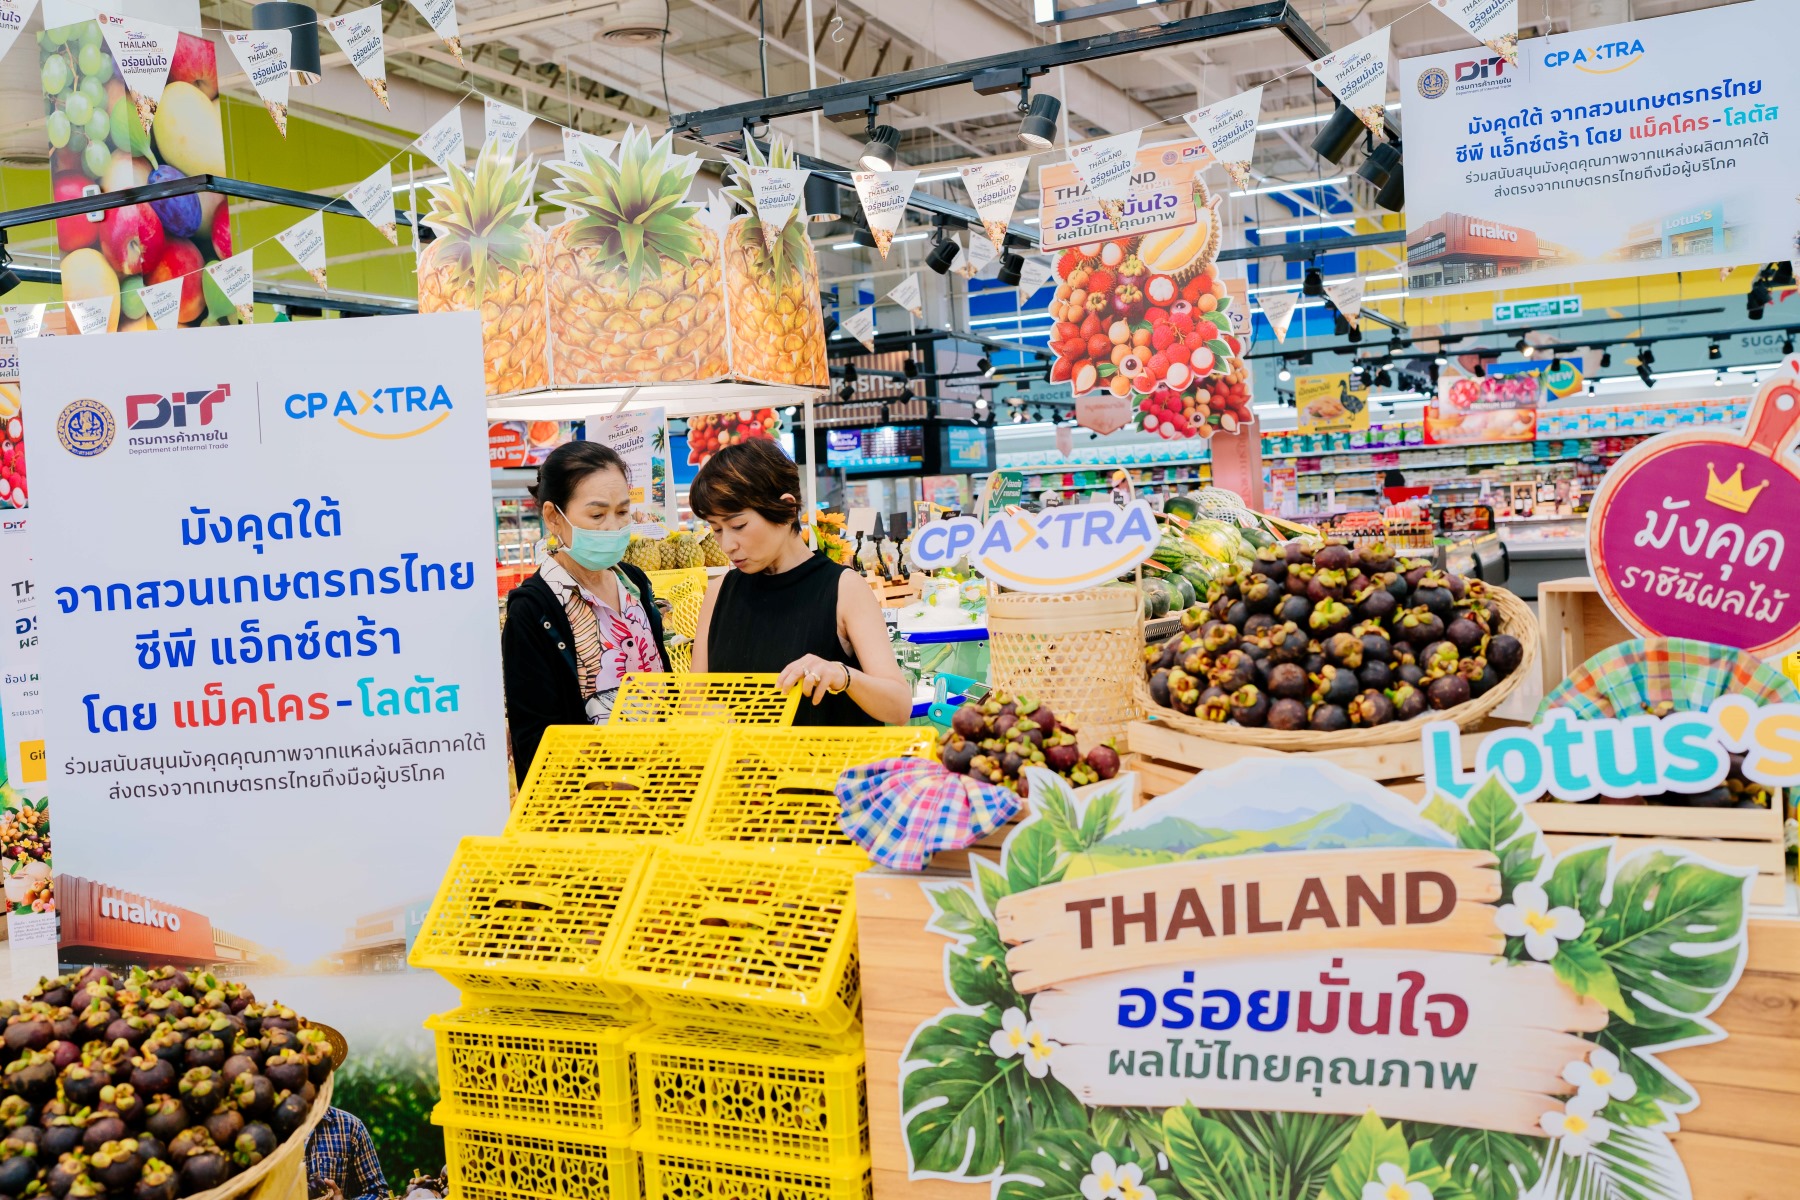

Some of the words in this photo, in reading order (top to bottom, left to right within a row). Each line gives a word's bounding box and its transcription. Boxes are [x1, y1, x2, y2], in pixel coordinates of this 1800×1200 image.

[119, 40, 157, 49] THAILAND
[122, 53, 167, 67] อร่อยมั่นใจ
[1455, 56, 1508, 83] DiT
[1544, 50, 1570, 69] CP
[1572, 39, 1645, 65] AXTRA
[1335, 53, 1372, 82] THAILAND
[1340, 61, 1384, 96] อร่อยมั่นใจ
[1456, 77, 1512, 91] กรมการค้าภายใน
[1208, 110, 1243, 135] THAILAND
[1468, 104, 1543, 137] มังคุดใต้
[1551, 77, 1763, 122] จากสวนเกษตรกรไทย
[1212, 118, 1254, 149] อร่อยมั่นใจ
[1456, 143, 1484, 164] ซีพี
[1491, 129, 1580, 158] แอ็กซ์ตร้า
[1587, 126, 1622, 147] โดย
[1088, 149, 1122, 171] THAILAND
[1090, 160, 1131, 185] อร่อยมั่นใจ
[1465, 130, 1770, 184] ร่วมสนับสนุนมังคุดคุณภาพจากแหล่งผลิตภาคใต้
[1054, 171, 1157, 200] THAND
[1494, 156, 1737, 199] ส่งตรงจากเกษตรกรไทยถึงมือผู้บริโภค
[1469, 222, 1519, 243] makro
[1665, 208, 1713, 230] Lotus's
[1548, 370, 1573, 383] NEW
[126, 384, 231, 430] DiT
[284, 391, 327, 420] CP
[333, 384, 453, 416] AXTRA
[129, 430, 229, 446] กรมการค้าภายใน
[129, 446, 171, 455] Department
[180, 444, 207, 452] Internal
[608, 426, 638, 440] THAILAND
[181, 496, 341, 555] มังคุดใต้
[917, 523, 975, 562] CP
[978, 507, 1151, 555] AXTRA
[1634, 496, 1786, 581] มังคุด
[55, 552, 475, 615] จากสวนเกษตรกรไทย
[1620, 566, 1790, 623] ราชินีผลไม้
[136, 628, 195, 670] ซีพี
[212, 616, 401, 666] แอ็กซ์ตร้า
[82, 693, 157, 734] โดย
[65, 733, 487, 776] ร่วมสนับสนุนมังคุดคุณภาพจากแหล่งผลิตภาคใต้
[109, 764, 446, 800] ส่งตรงจากเกษตรกรไทยถึงมือผู้บริโภค
[101, 896, 181, 933] makro
[1065, 869, 1459, 951] THAILAND
[1117, 958, 1469, 1040] อร่อยมั่นใจ
[1108, 1038, 1478, 1098] ผลไม้ไทยคุณภาพ
